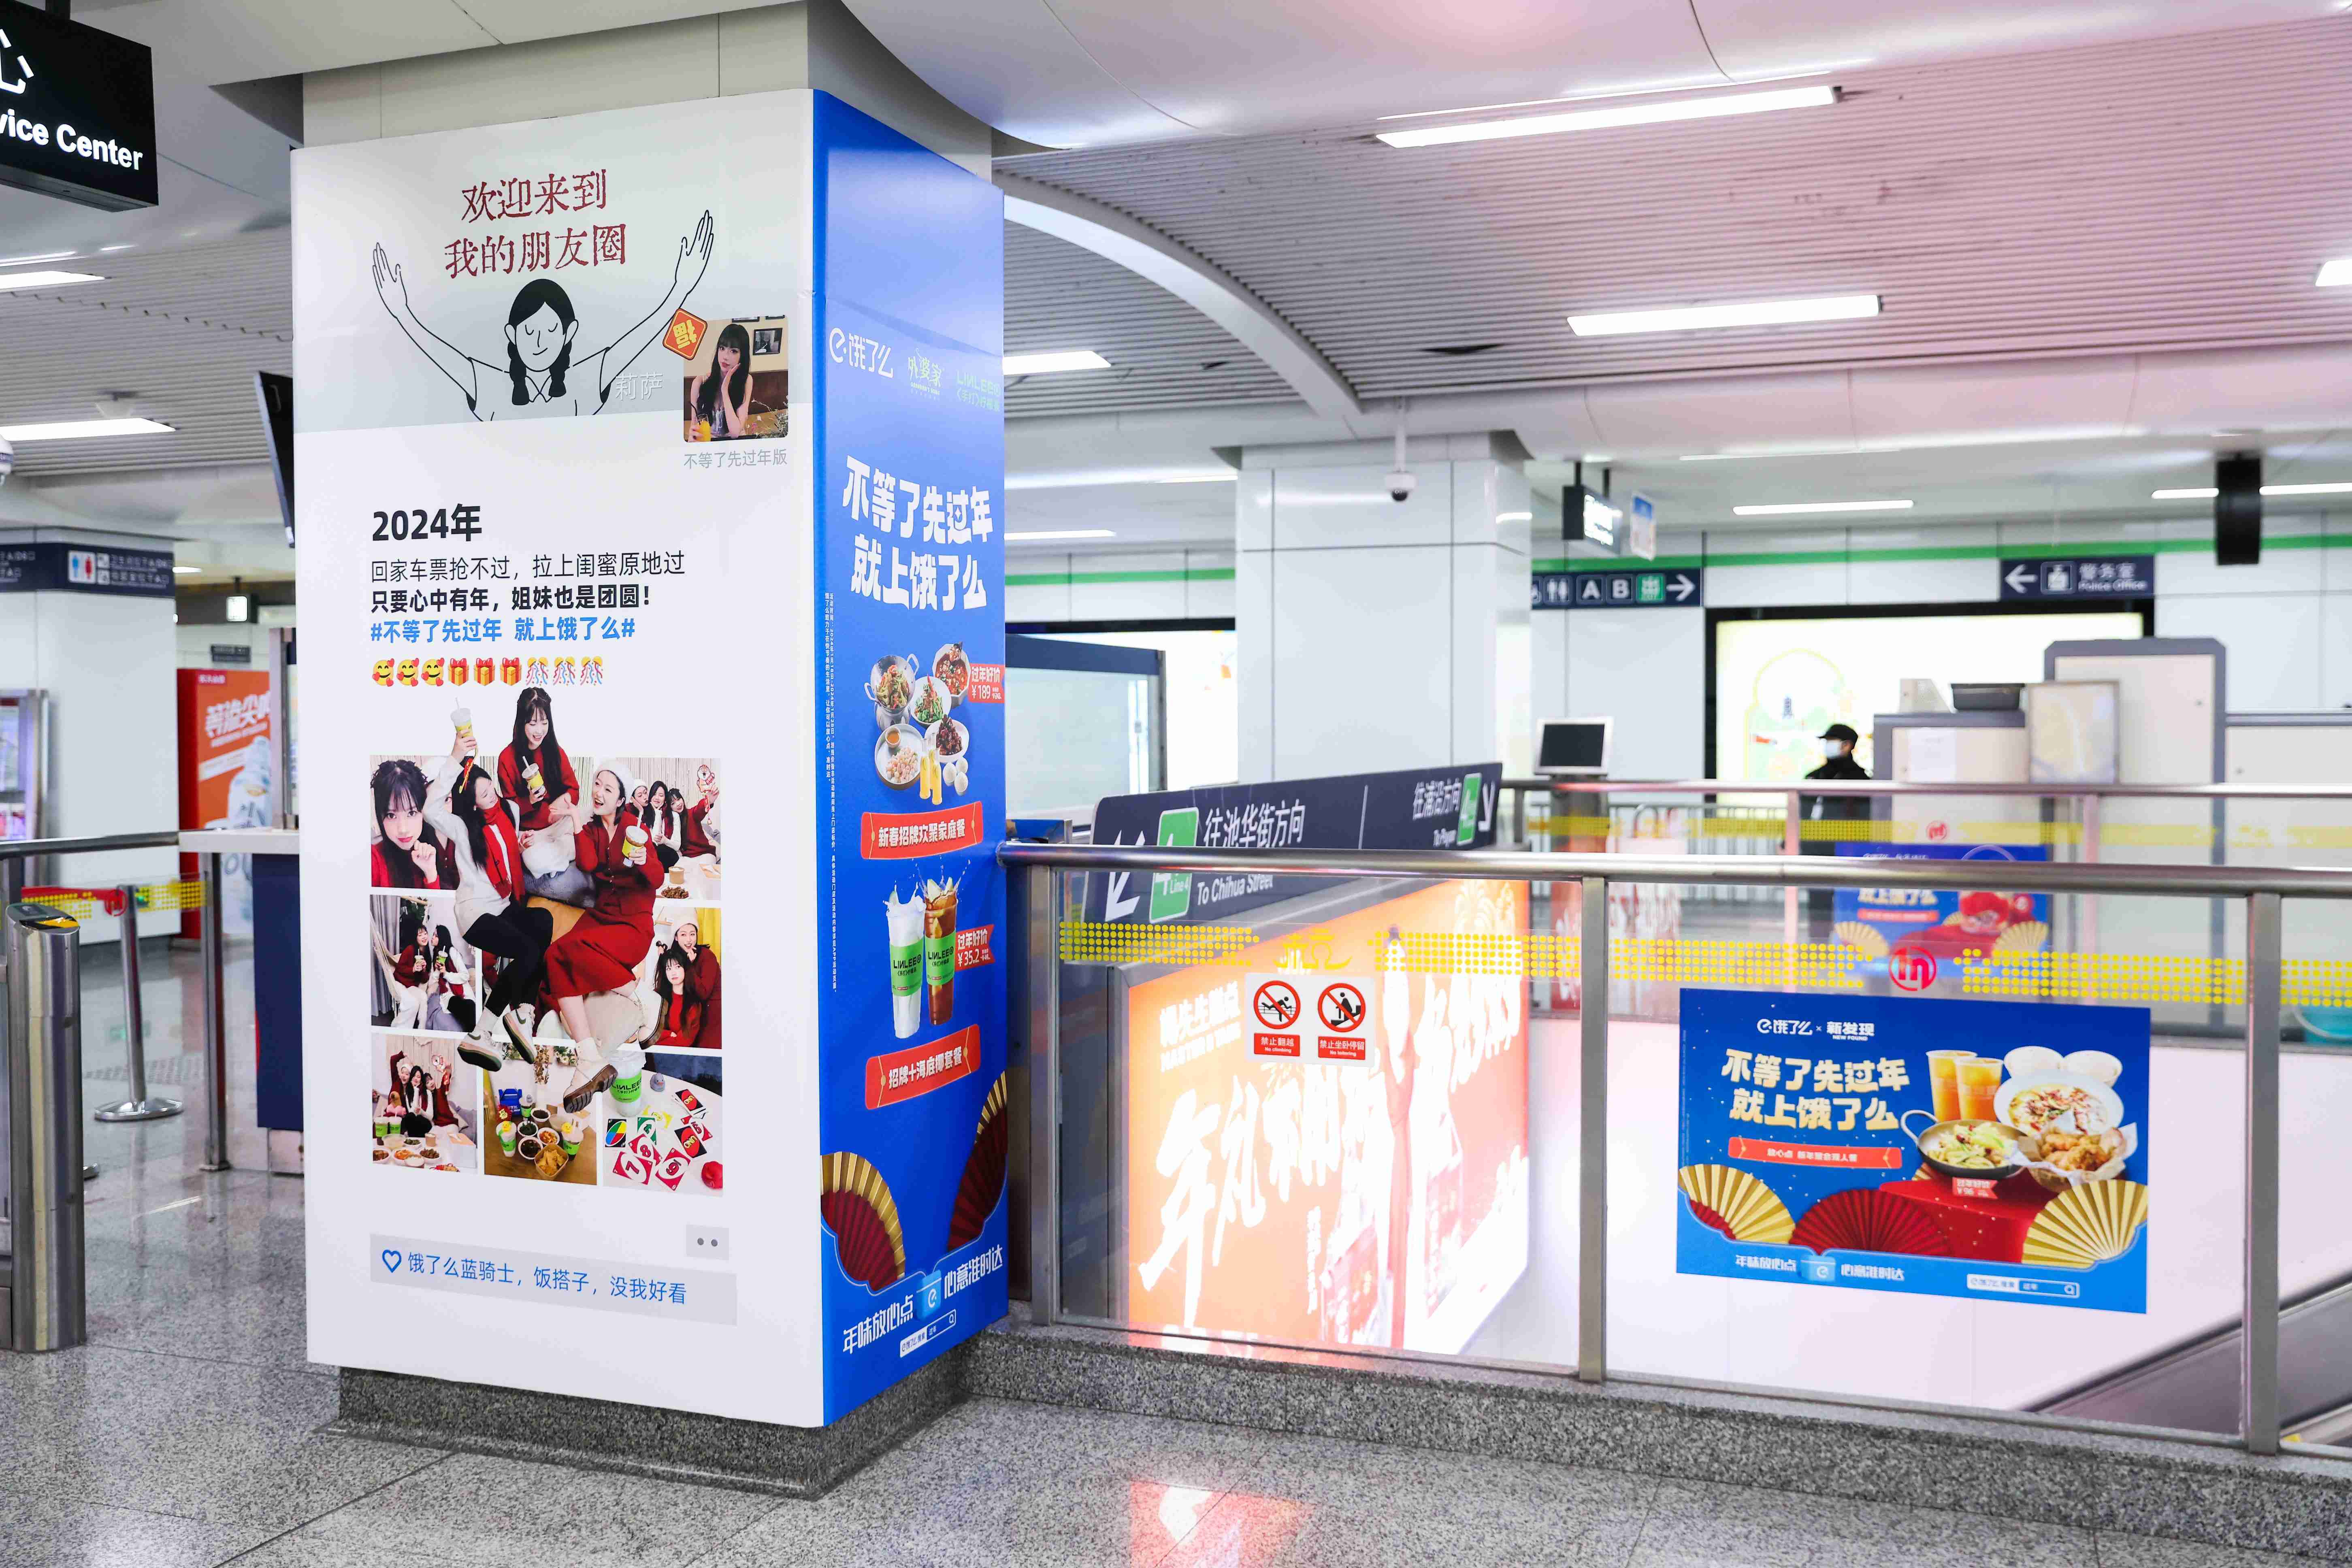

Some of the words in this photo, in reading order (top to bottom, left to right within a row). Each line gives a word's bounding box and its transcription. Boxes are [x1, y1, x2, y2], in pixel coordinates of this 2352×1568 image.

[56, 124, 143, 170] Center
[461, 169, 607, 223] 欢迎来到
[444, 224, 626, 278] 我的朋友圈
[848, 333, 894, 379] 饿了么
[615, 371, 664, 401] 莉萨
[683, 448, 788, 470] 不等了先过年版
[842, 455, 993, 544] 不等了先过年
[372, 503, 482, 542] 2024年
[851, 533, 987, 611] 就上饿了么
[2078, 580, 2113, 592] Police
[2113, 579, 2148, 591] Office
[1582, 579, 1601, 599] A
[1612, 579, 1630, 599] B
[371, 618, 503, 643] #不等了先过年
[514, 616, 635, 641] 就上饿了么#
[971, 667, 1000, 682] 过年好价
[878, 818, 966, 848] 新春招牌欢聚家庭餐
[1204, 799, 1306, 848] 往池华街方向
[1197, 882, 1209, 905] To
[1212, 875, 1245, 902] Chihua
[1247, 874, 1273, 894] Street
[958, 928, 988, 950] 过年好价
[1260, 1036, 1295, 1047] 禁止翻越
[1773, 1020, 1813, 1036] 饿了么
[1826, 1021, 1875, 1037] 新发现
[1319, 1039, 1365, 1050] 禁止坐卧停留
[1721, 1048, 1910, 1094] 不等了先过年
[1730, 1088, 1899, 1131] 就上饿了么
[640, 1144, 651, 1157] 8
[626, 1161, 639, 1174] 7
[1735, 1254, 1797, 1272] 年味放心点
[1841, 1263, 1905, 1281] 心意准时达
[843, 1293, 914, 1354] 年味放心点
[944, 1244, 1003, 1300] 心意准时达
